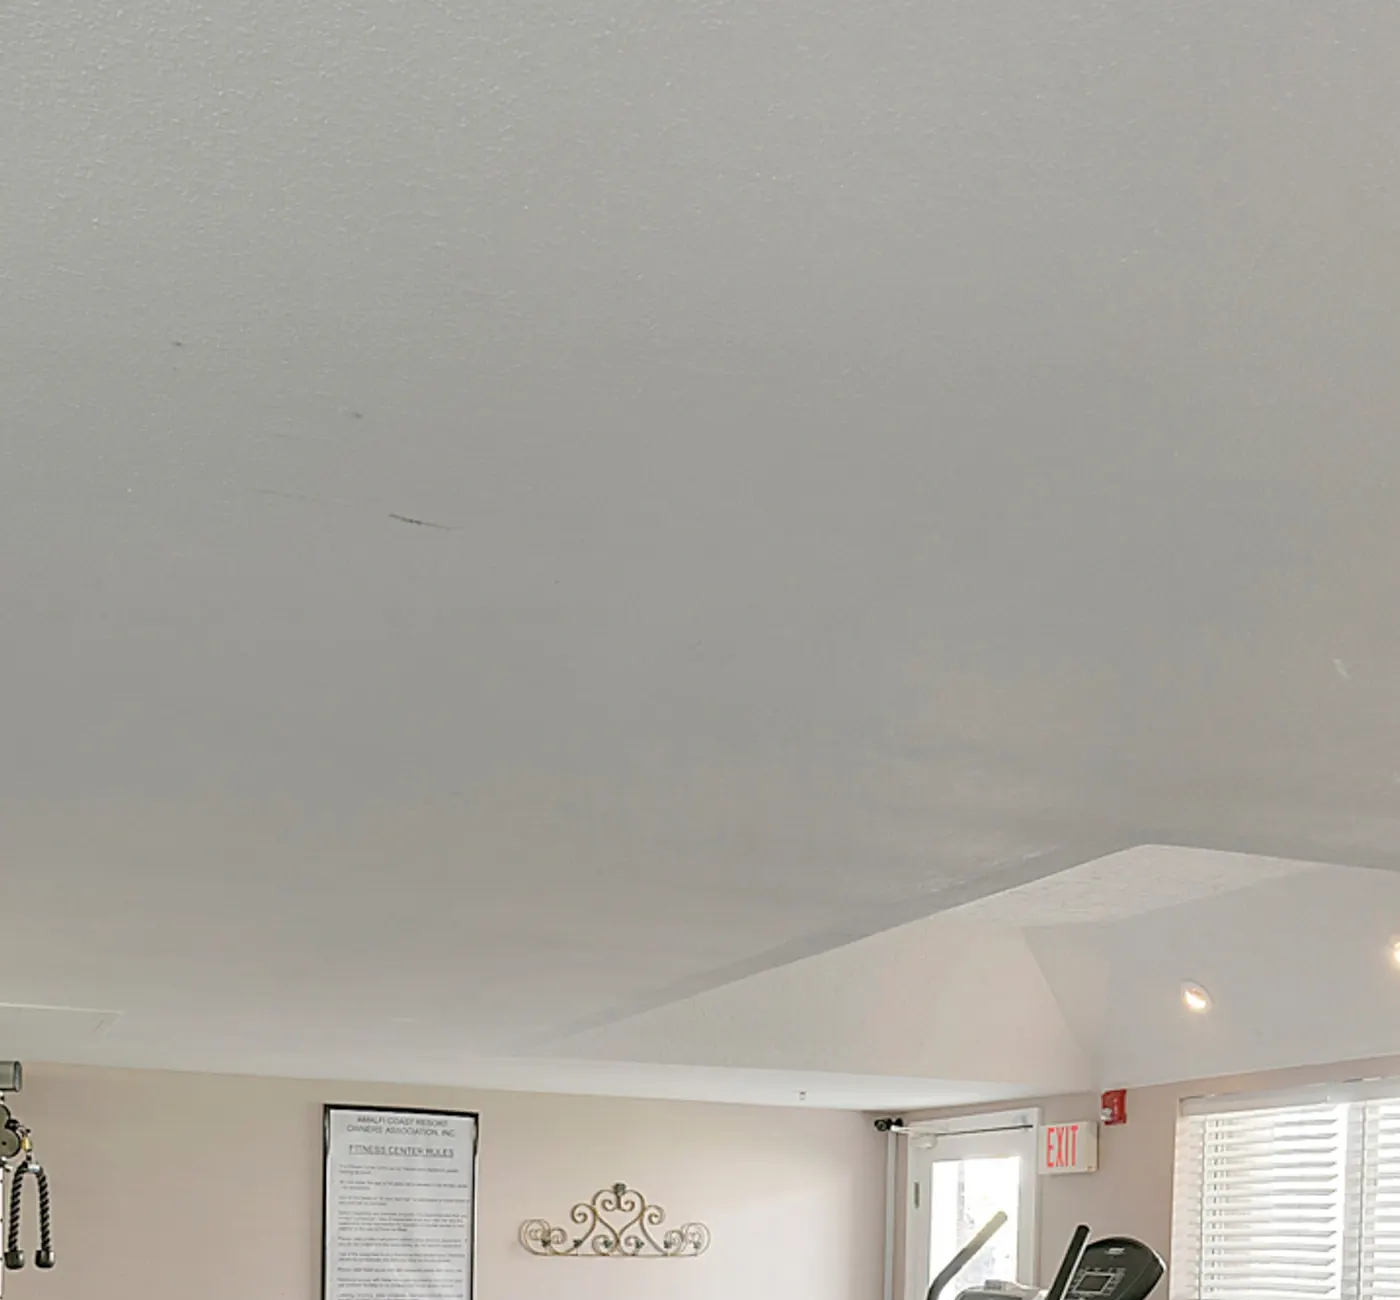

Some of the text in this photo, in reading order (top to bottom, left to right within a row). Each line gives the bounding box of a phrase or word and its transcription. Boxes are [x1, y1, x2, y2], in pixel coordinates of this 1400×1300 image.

[387, 1116, 415, 1126] COAST
[346, 1124, 383, 1134] OWNERS
[349, 1144, 454, 1159] FITNESS CENTER RULES
[1046, 1125, 1079, 1168] EXIT
